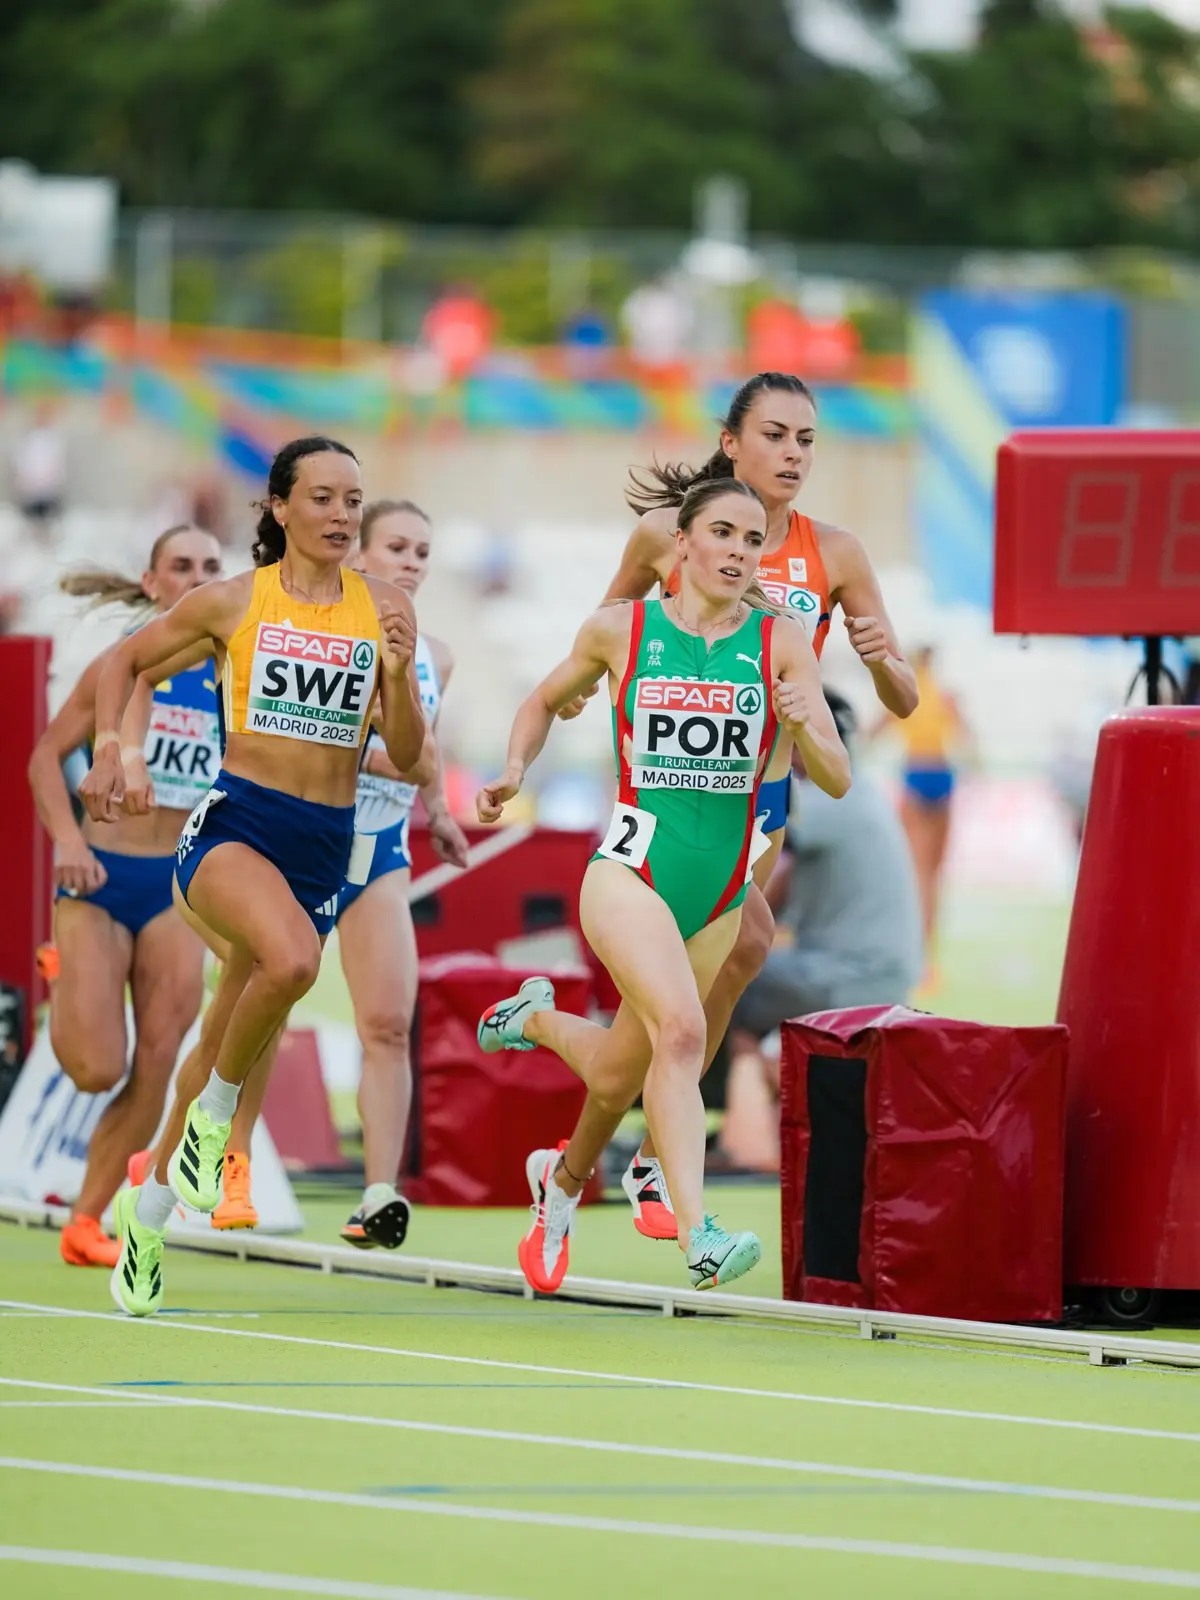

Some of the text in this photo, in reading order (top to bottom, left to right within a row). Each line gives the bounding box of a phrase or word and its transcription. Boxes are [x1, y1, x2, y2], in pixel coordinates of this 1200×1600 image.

[261, 629, 350, 663] SPAR
[262, 659, 365, 711] SWE
[640, 685, 731, 710] SPAR
[277, 702, 303, 715] RUN
[253, 713, 355, 743] MADRID 2025
[647, 713, 750, 757] POR
[664, 758, 690, 768] RUN
[642, 770, 748, 789] MADRID 2025
[612, 815, 638, 857] 2
